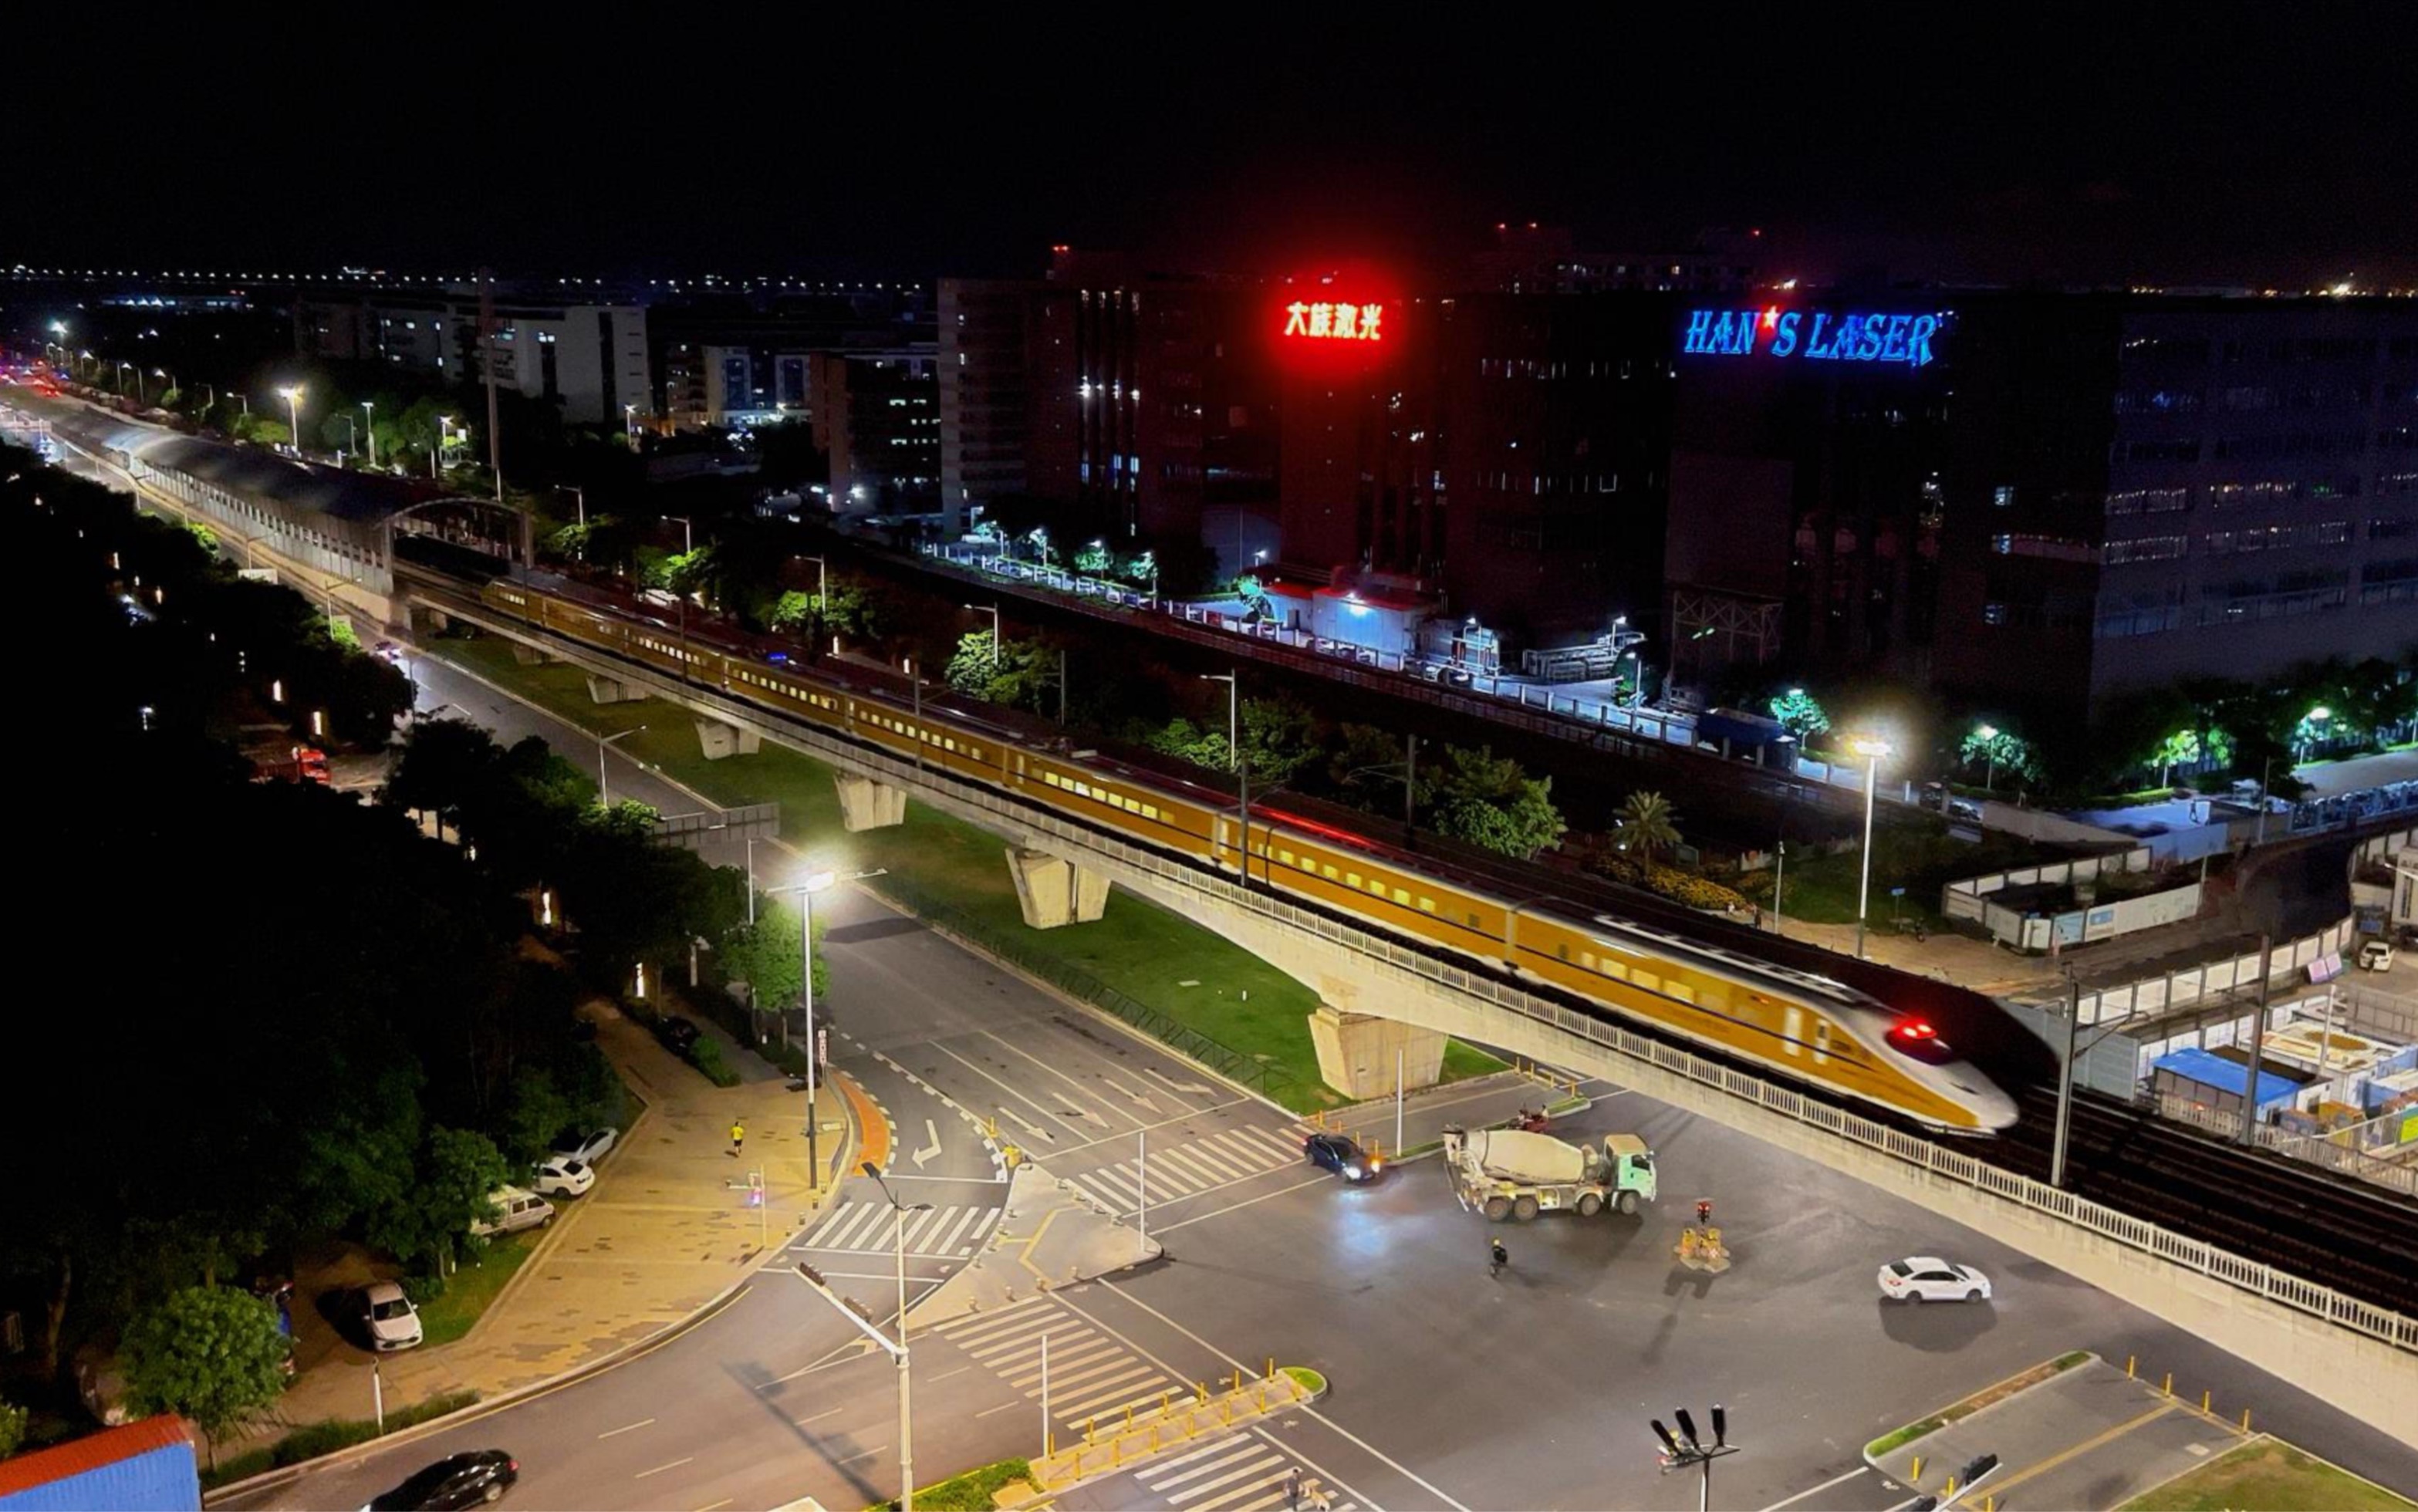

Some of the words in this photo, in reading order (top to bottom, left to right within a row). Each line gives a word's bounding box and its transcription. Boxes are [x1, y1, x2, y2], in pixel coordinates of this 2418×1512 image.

[1285, 301, 1382, 340] 大族激光
[1804, 312, 1937, 366] LASER
